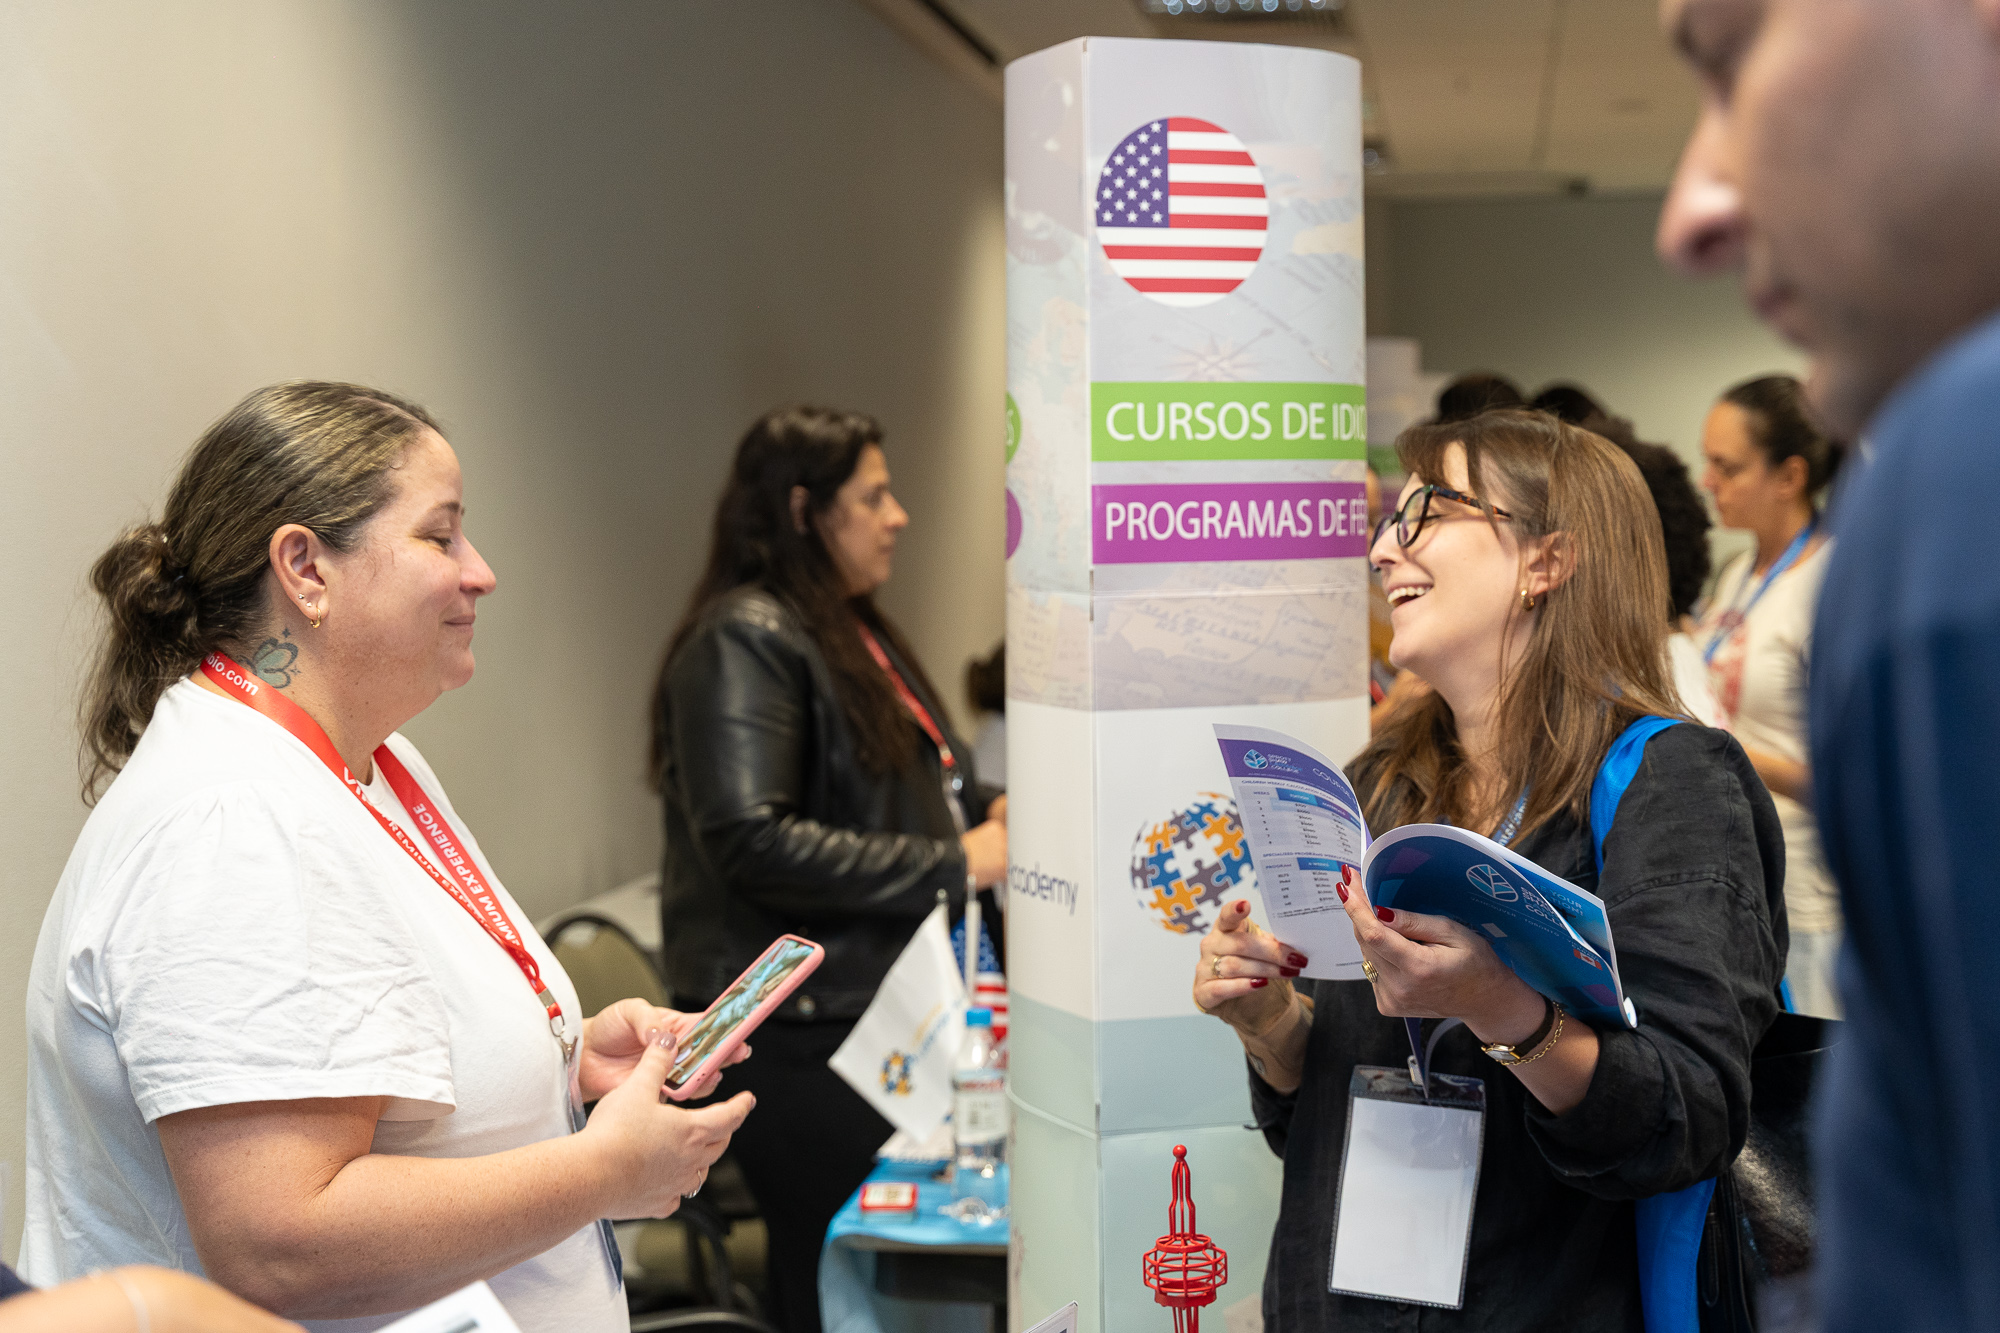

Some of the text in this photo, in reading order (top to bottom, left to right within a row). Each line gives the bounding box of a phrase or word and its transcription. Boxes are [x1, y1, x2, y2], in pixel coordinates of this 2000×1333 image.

[1106, 402, 1272, 441] CURSOS
[1283, 402, 1326, 440] DE
[1106, 499, 1313, 541] PROGRAMAS
[1318, 499, 1348, 537] DE
[206, 654, 260, 696] bio.com
[412, 802, 484, 896] EXPERIENCE
[1550, 896, 1584, 917] TION!
